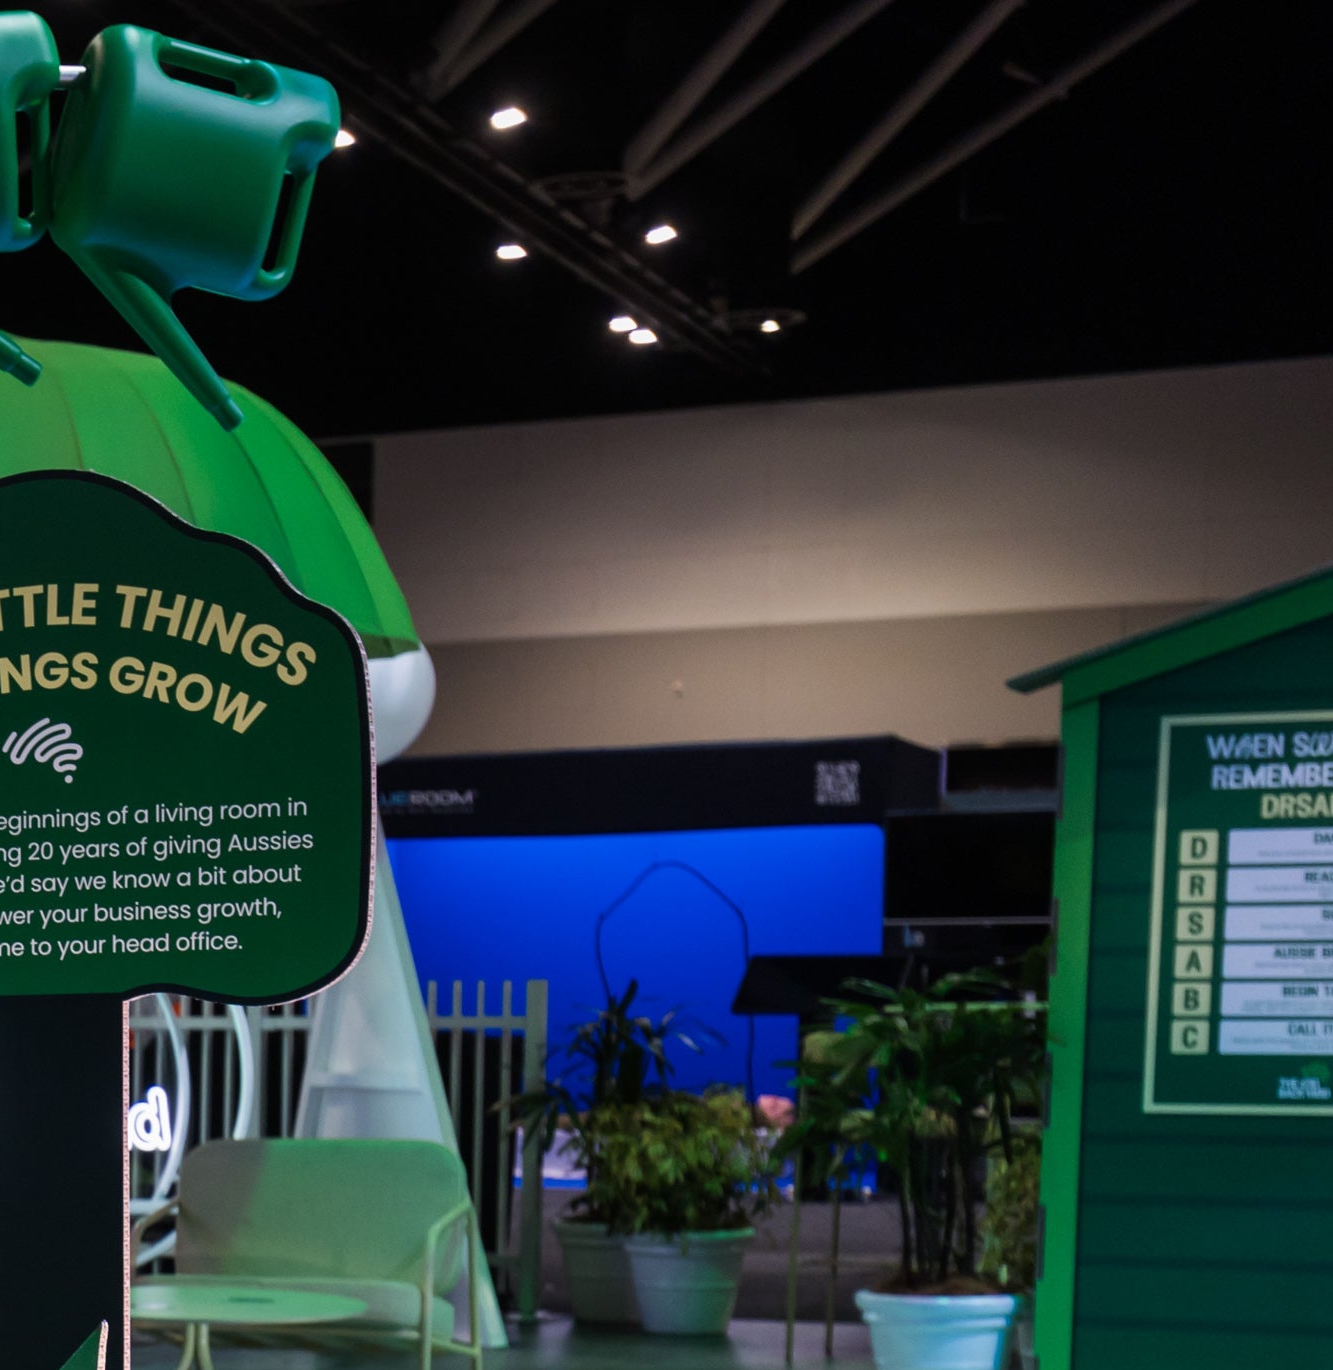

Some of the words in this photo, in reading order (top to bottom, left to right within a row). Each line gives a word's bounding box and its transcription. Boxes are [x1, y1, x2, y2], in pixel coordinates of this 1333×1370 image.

[116, 584, 317, 686] THINGS
[109, 656, 268, 734] GROW
[107, 806, 128, 825] of
[135, 809, 148, 823] a
[156, 803, 212, 827] living
[221, 803, 280, 819] room
[289, 798, 307, 816] in
[28, 842, 53, 861] 20
[60, 843, 119, 865] years
[126, 837, 147, 857] of
[154, 834, 220, 861] giving
[228, 830, 313, 852] Aussies
[1191, 836, 1207, 859] D
[31, 877, 69, 898] say
[75, 876, 106, 890] we
[113, 870, 170, 888] know
[177, 872, 191, 886] a
[199, 865, 226, 885] bit
[233, 864, 301, 884] about
[1190, 875, 1205, 897] R
[40, 908, 88, 929] your
[95, 901, 191, 922] business
[197, 897, 281, 924] growth,
[1188, 911, 1203, 935] S
[30, 939, 52, 955] to
[57, 940, 106, 961] your
[113, 932, 169, 953] head
[176, 930, 242, 952] office.
[1186, 951, 1201, 972] A
[1184, 988, 1199, 1012] B
[1183, 1025, 1199, 1049] C
